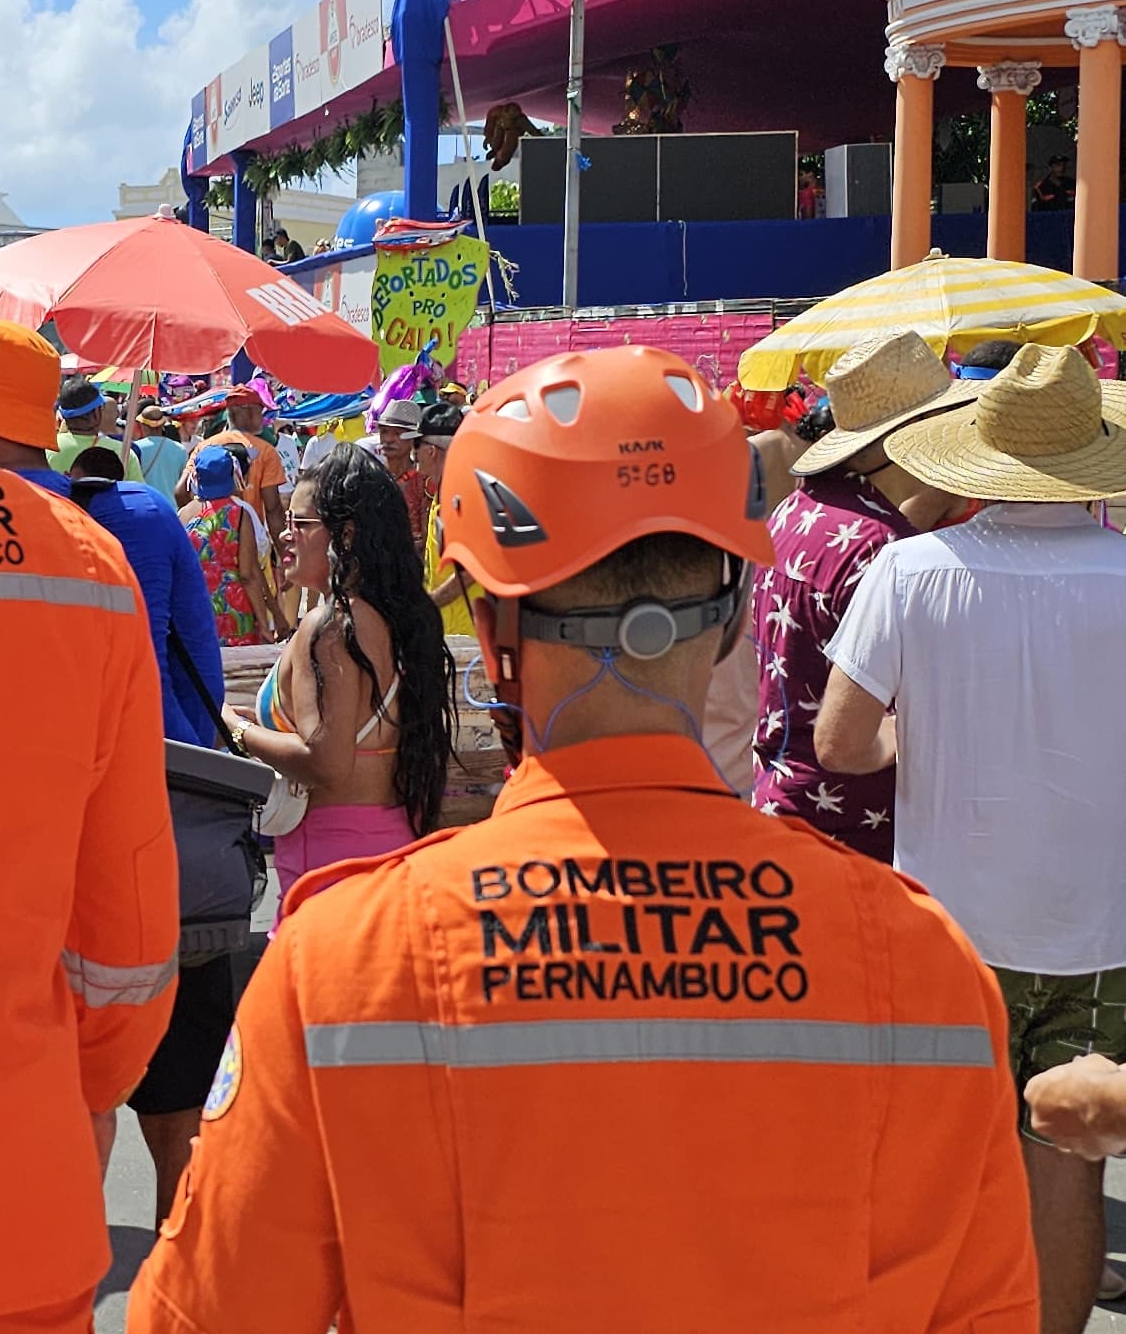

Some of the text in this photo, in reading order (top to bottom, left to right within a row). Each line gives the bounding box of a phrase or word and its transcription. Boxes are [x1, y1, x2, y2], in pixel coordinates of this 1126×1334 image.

[374, 257, 478, 330] DEPORTADOS
[413, 300, 446, 318] PRO
[472, 858, 793, 901] BOMBEIRO
[479, 903, 802, 957] MILITAR
[482, 961, 809, 1003] PERNAMBUCO
